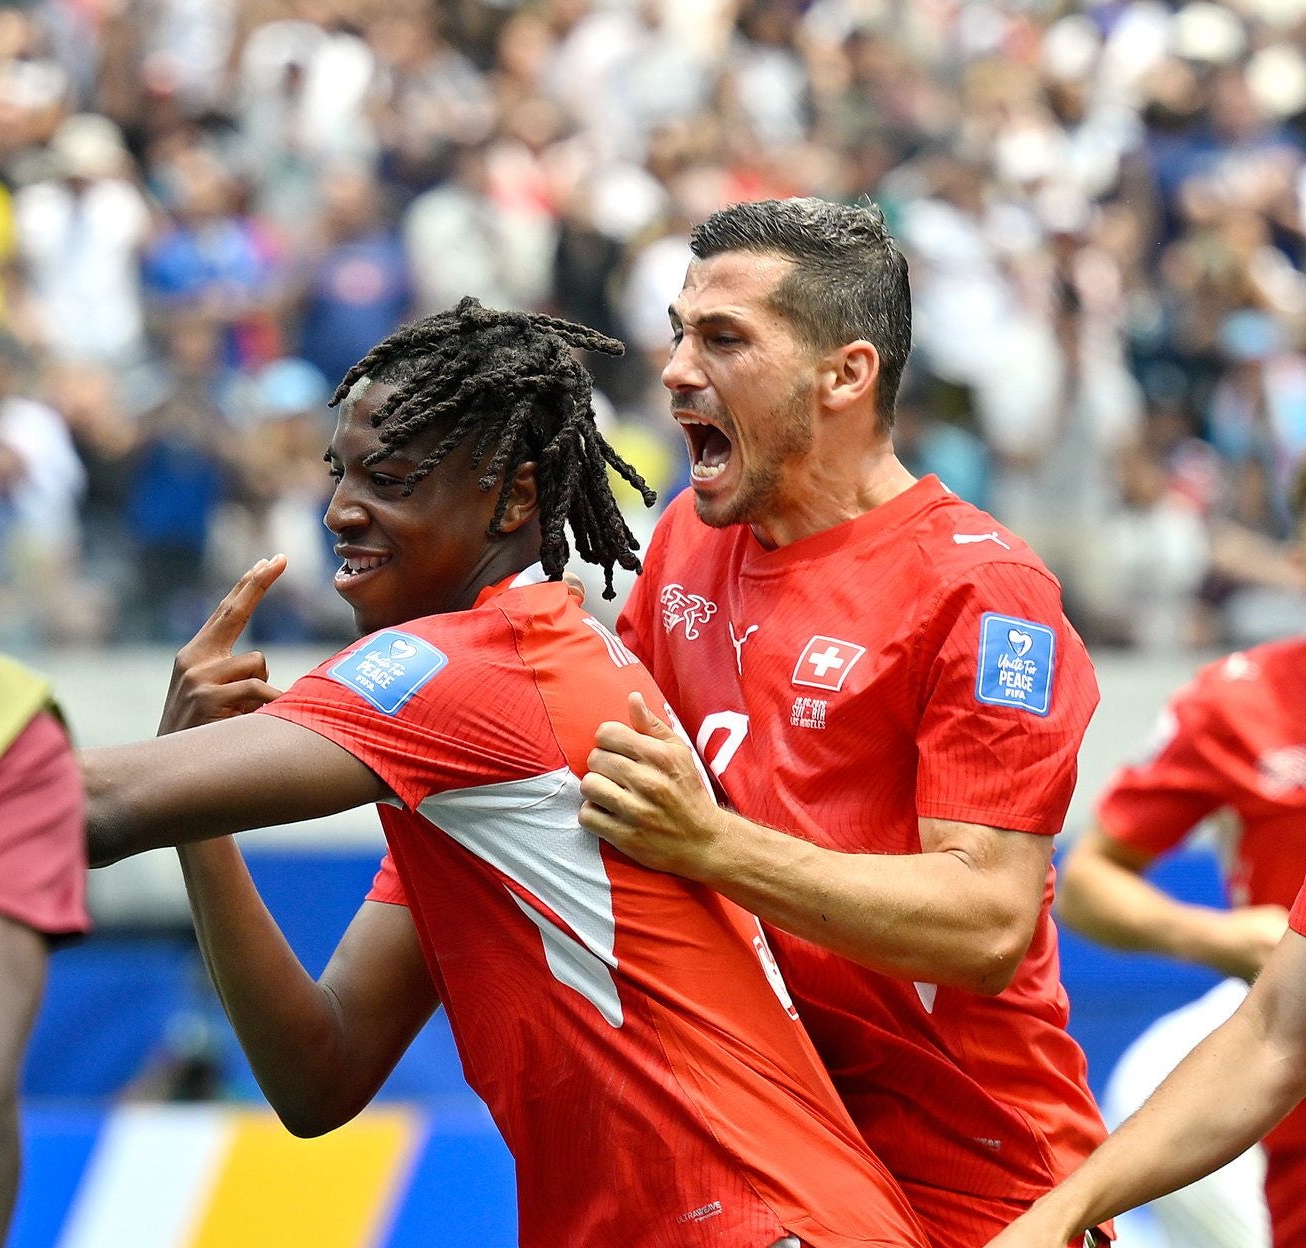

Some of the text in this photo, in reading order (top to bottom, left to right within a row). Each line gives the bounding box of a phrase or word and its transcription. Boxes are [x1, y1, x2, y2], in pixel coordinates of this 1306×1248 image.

[355, 660, 395, 690] PEACE
[997, 653, 1037, 675] Unite For
[998, 669, 1034, 693] PEACE
[1005, 688, 1026, 700] FIFA
[792, 704, 805, 718] SUI
[790, 716, 826, 730] LOS ANGELES
[676, 1200, 722, 1224] ULTRAWEAVE
